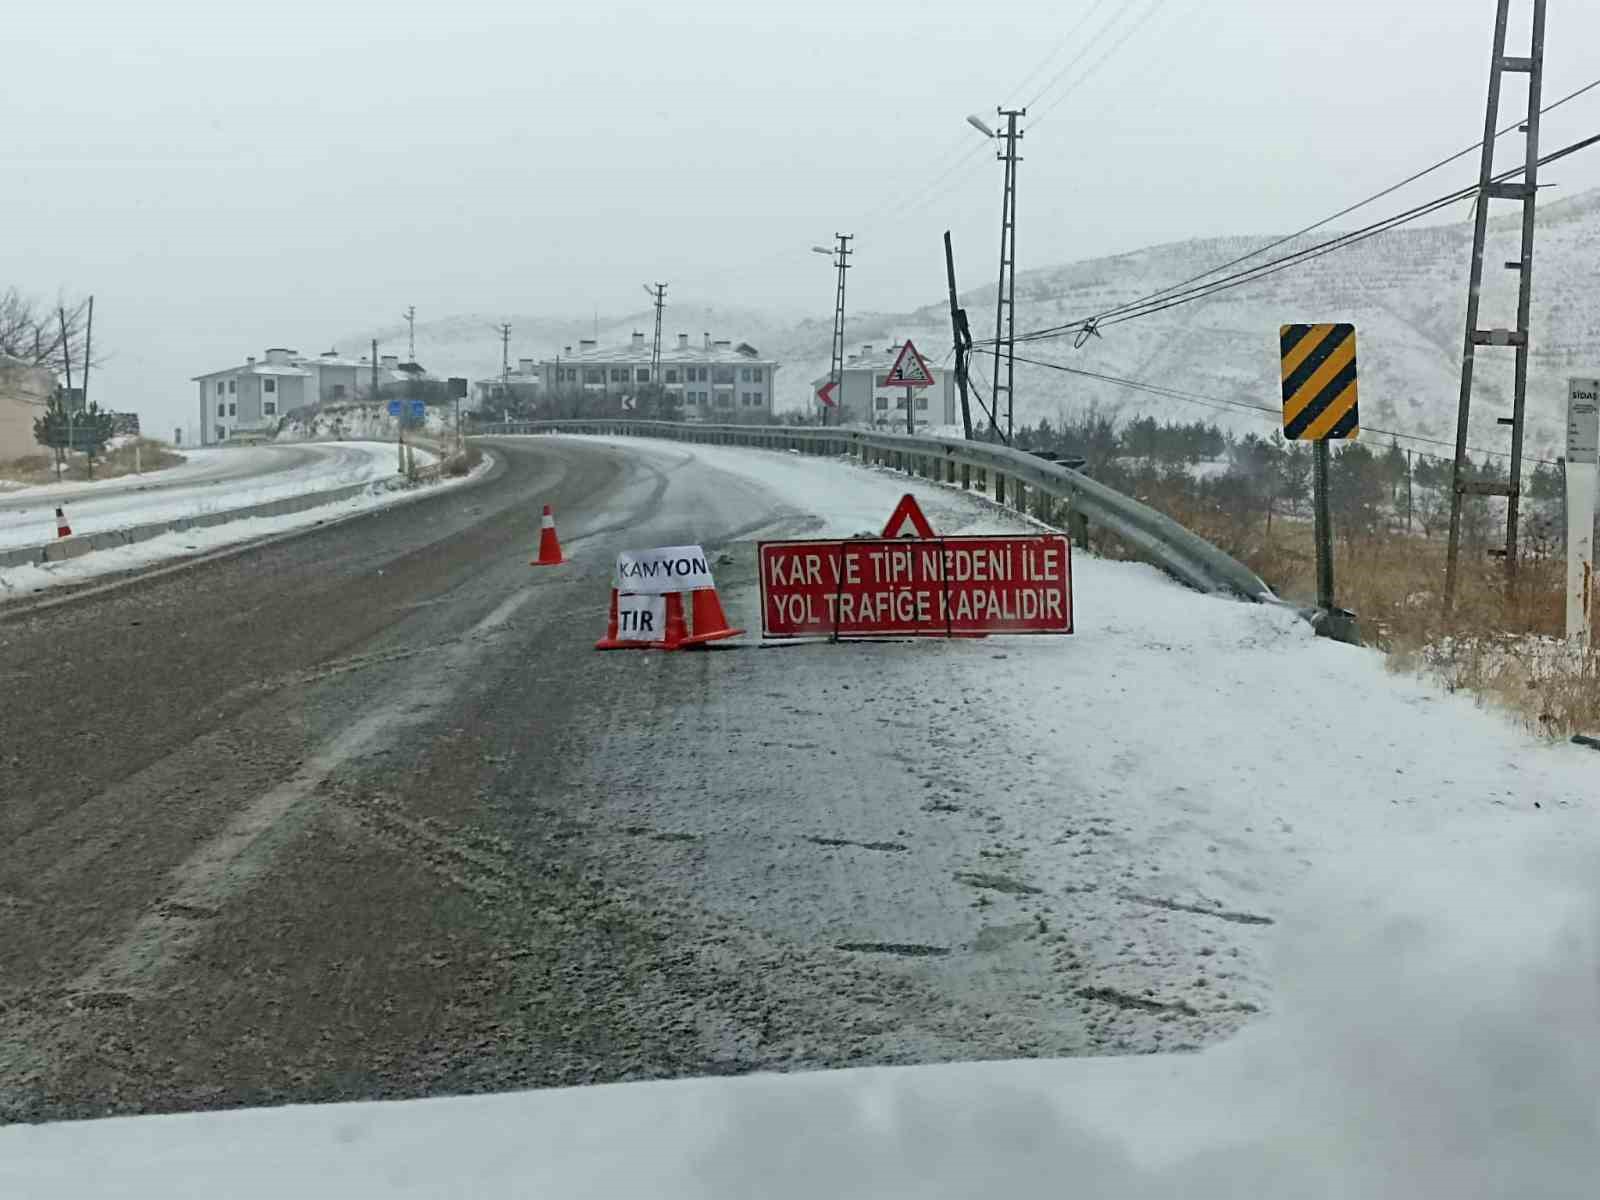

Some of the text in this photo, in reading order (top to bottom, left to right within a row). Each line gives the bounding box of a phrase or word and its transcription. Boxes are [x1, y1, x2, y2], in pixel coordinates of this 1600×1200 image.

[619, 558, 706, 577] KAMYON
[770, 543, 1058, 586] KAR VE TİPİ NEDENİ İLE
[773, 585, 1063, 624] YOL TRAFİĞE KAPALIDIR
[620, 610, 653, 632] TIR
